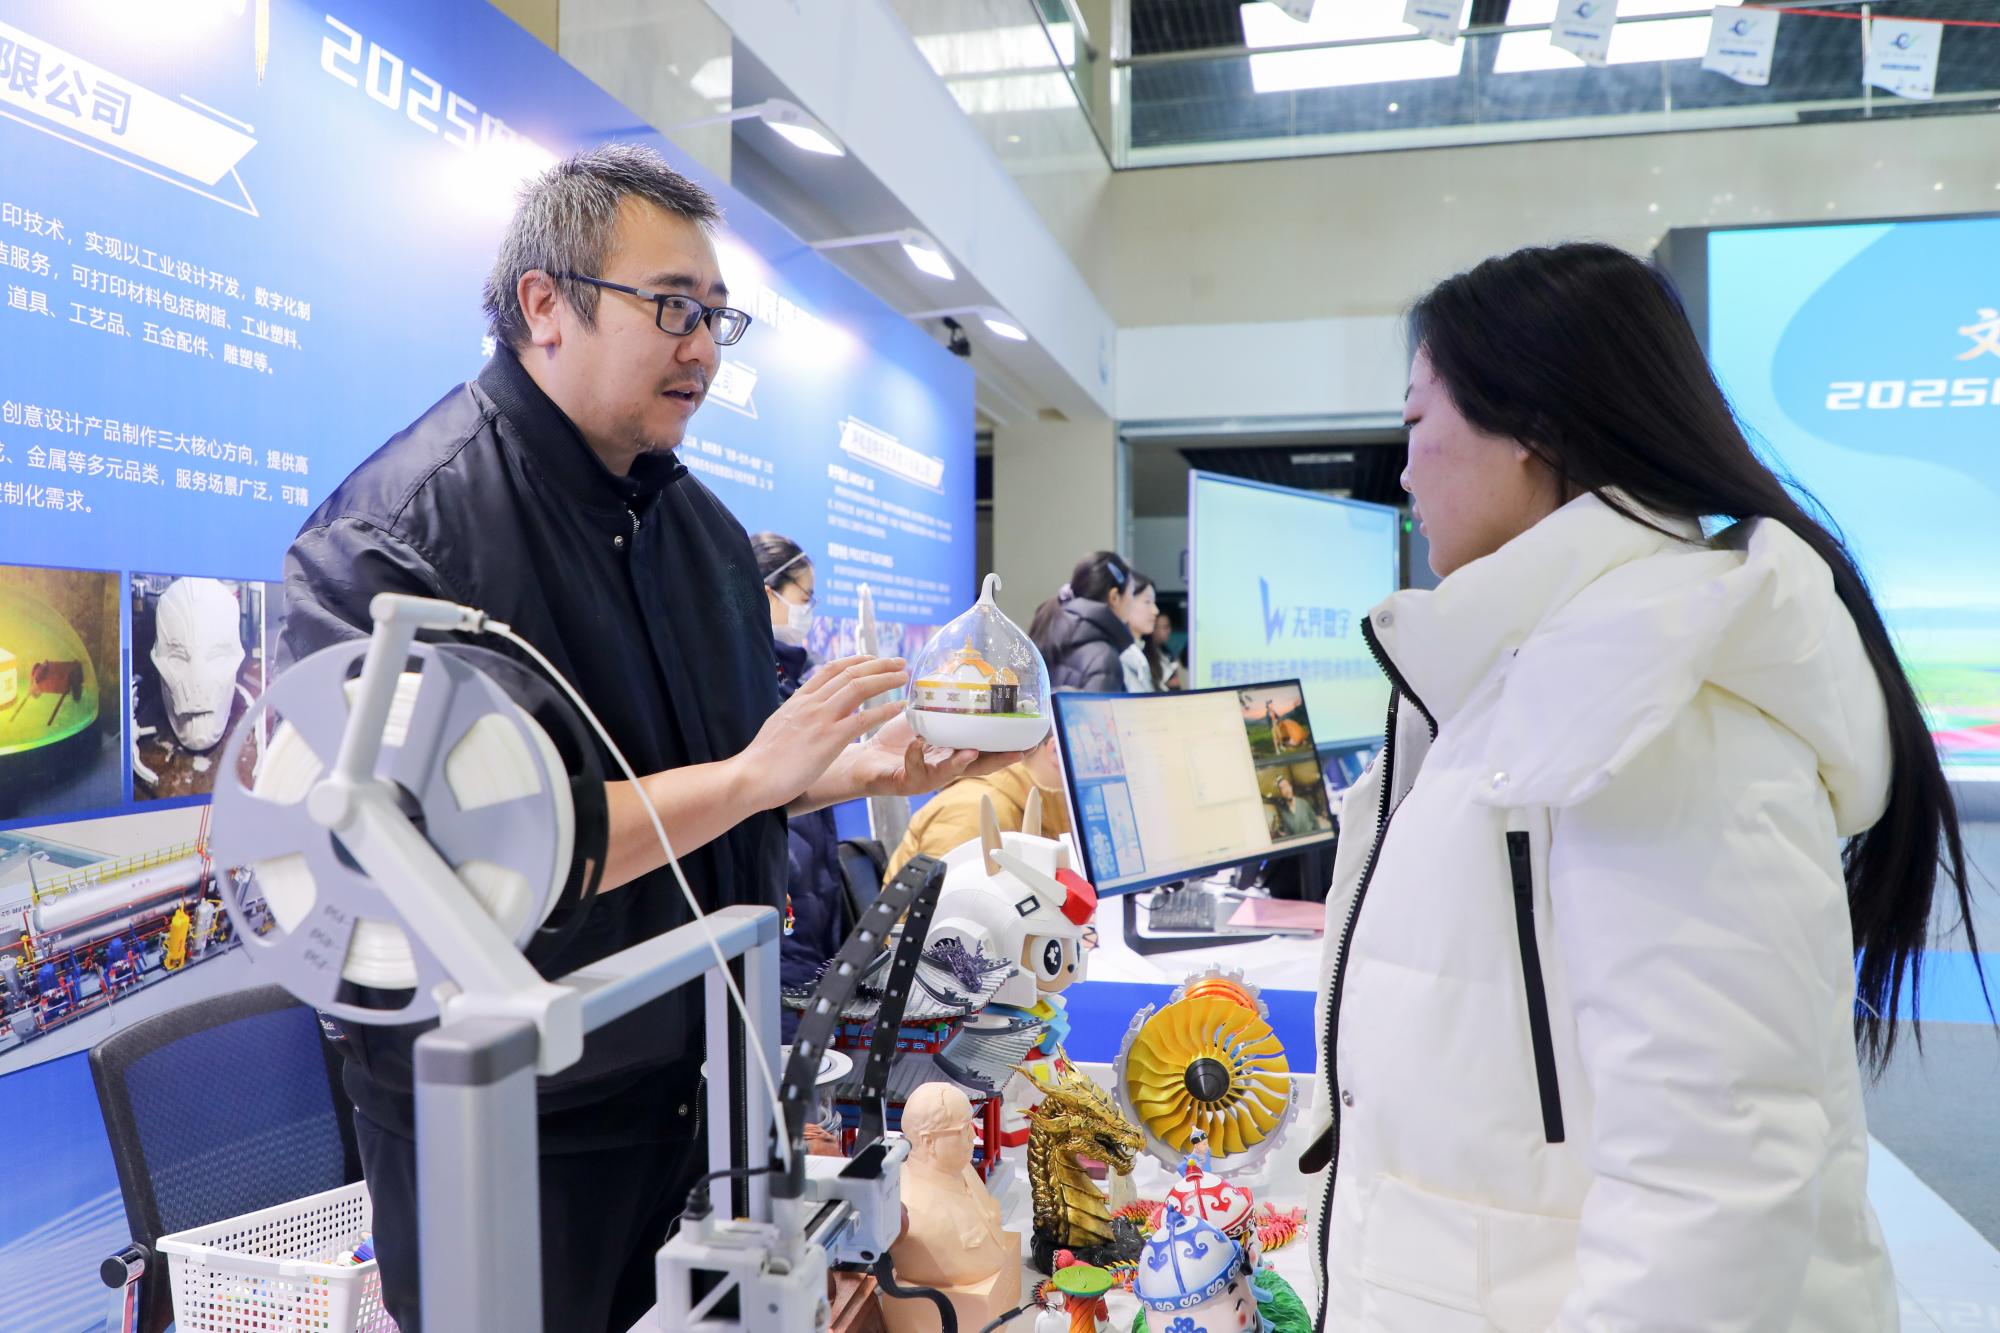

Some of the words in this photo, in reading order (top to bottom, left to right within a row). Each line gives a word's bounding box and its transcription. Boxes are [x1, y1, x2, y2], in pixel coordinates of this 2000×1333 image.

[2, 202, 311, 321] 印技术，实现以工业设计开发，数字化制
[8, 283, 273, 375] 道具、工艺品、五金配件、雕塑等。
[1825, 377, 2000, 411] 2025
[2, 400, 309, 475] 创意设计产品制作三大核心方向，提供高
[0, 442, 309, 507] 、金属等多元品类，服务场景广泛，可精
[0, 481, 92, 513] 制化需求。
